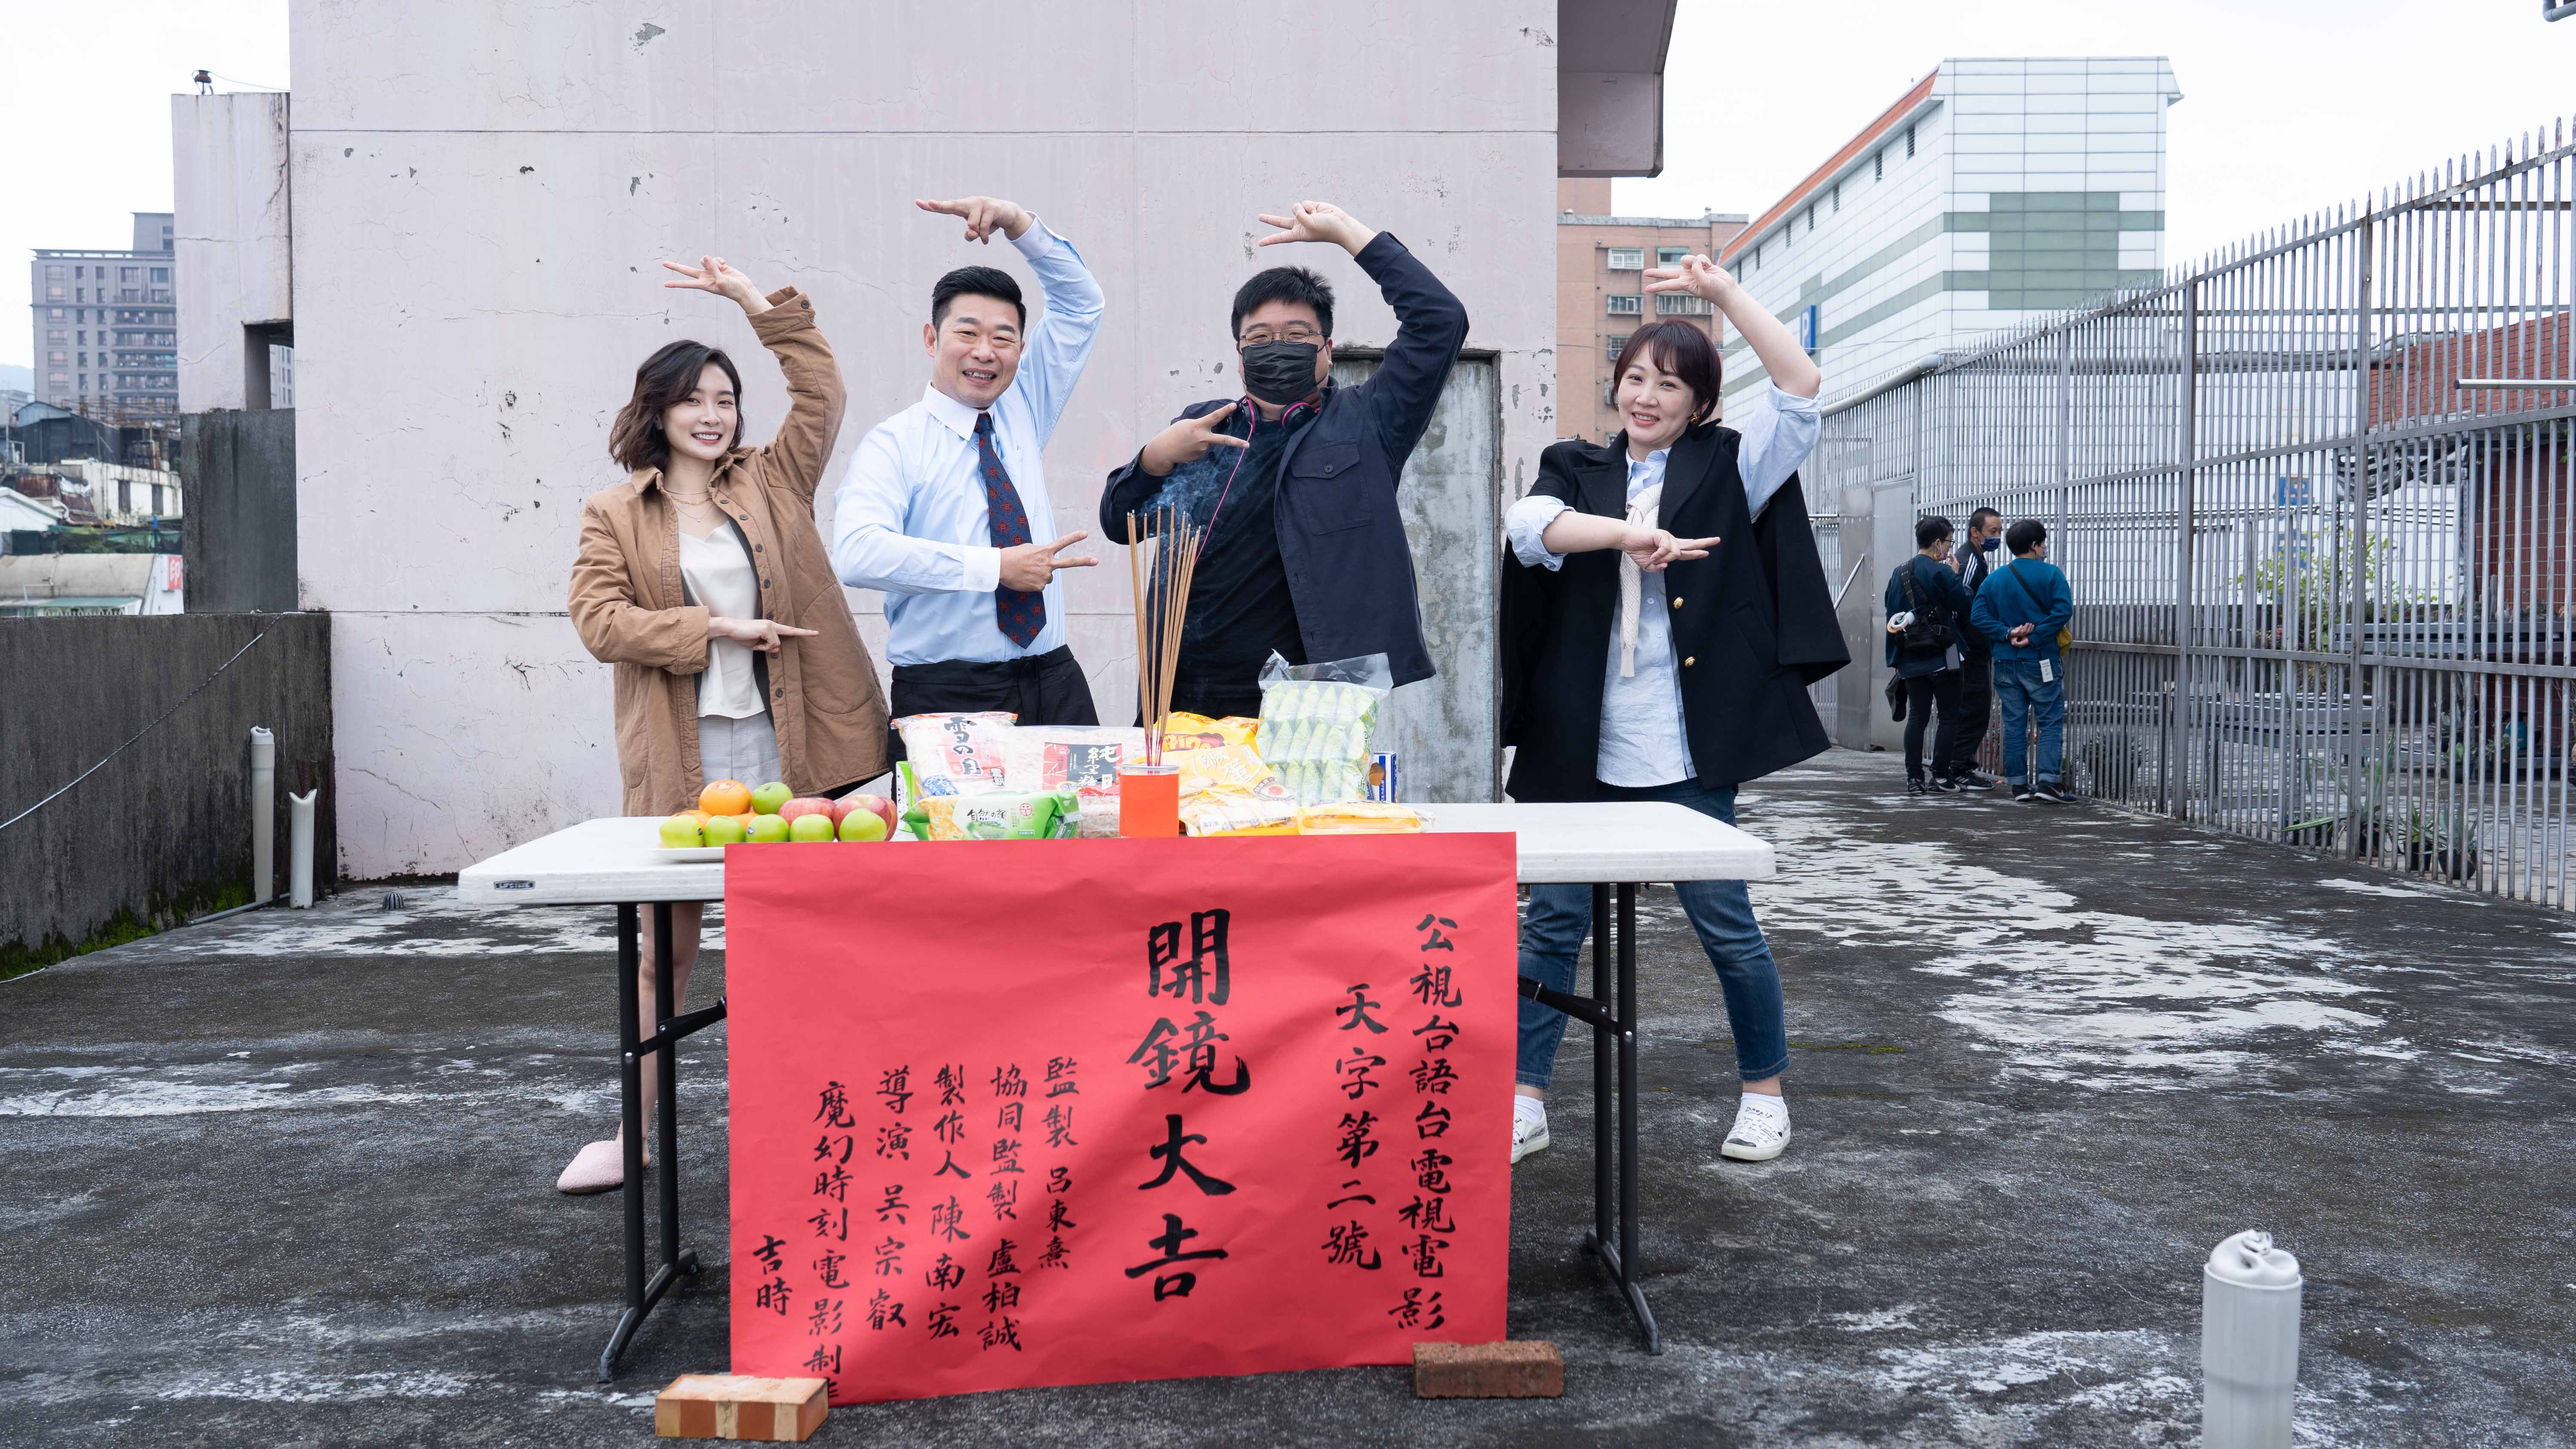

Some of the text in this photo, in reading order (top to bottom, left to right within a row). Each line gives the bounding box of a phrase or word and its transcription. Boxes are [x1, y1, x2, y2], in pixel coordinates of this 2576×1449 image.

[1802, 312, 1809, 347] P
[876, 1065, 914, 1161] 導演
[987, 1064, 1027, 1220] 協同監製
[1042, 1056, 1080, 1148] 監製
[1125, 908, 1250, 1302] 開鏡大吉
[1321, 983, 1389, 1270] 天字第二號
[1388, 913, 1462, 1331] 公視台語台電視電影
[753, 1235, 792, 1315] 吉時
[926, 1064, 971, 1340] 製作人 陳南宏
